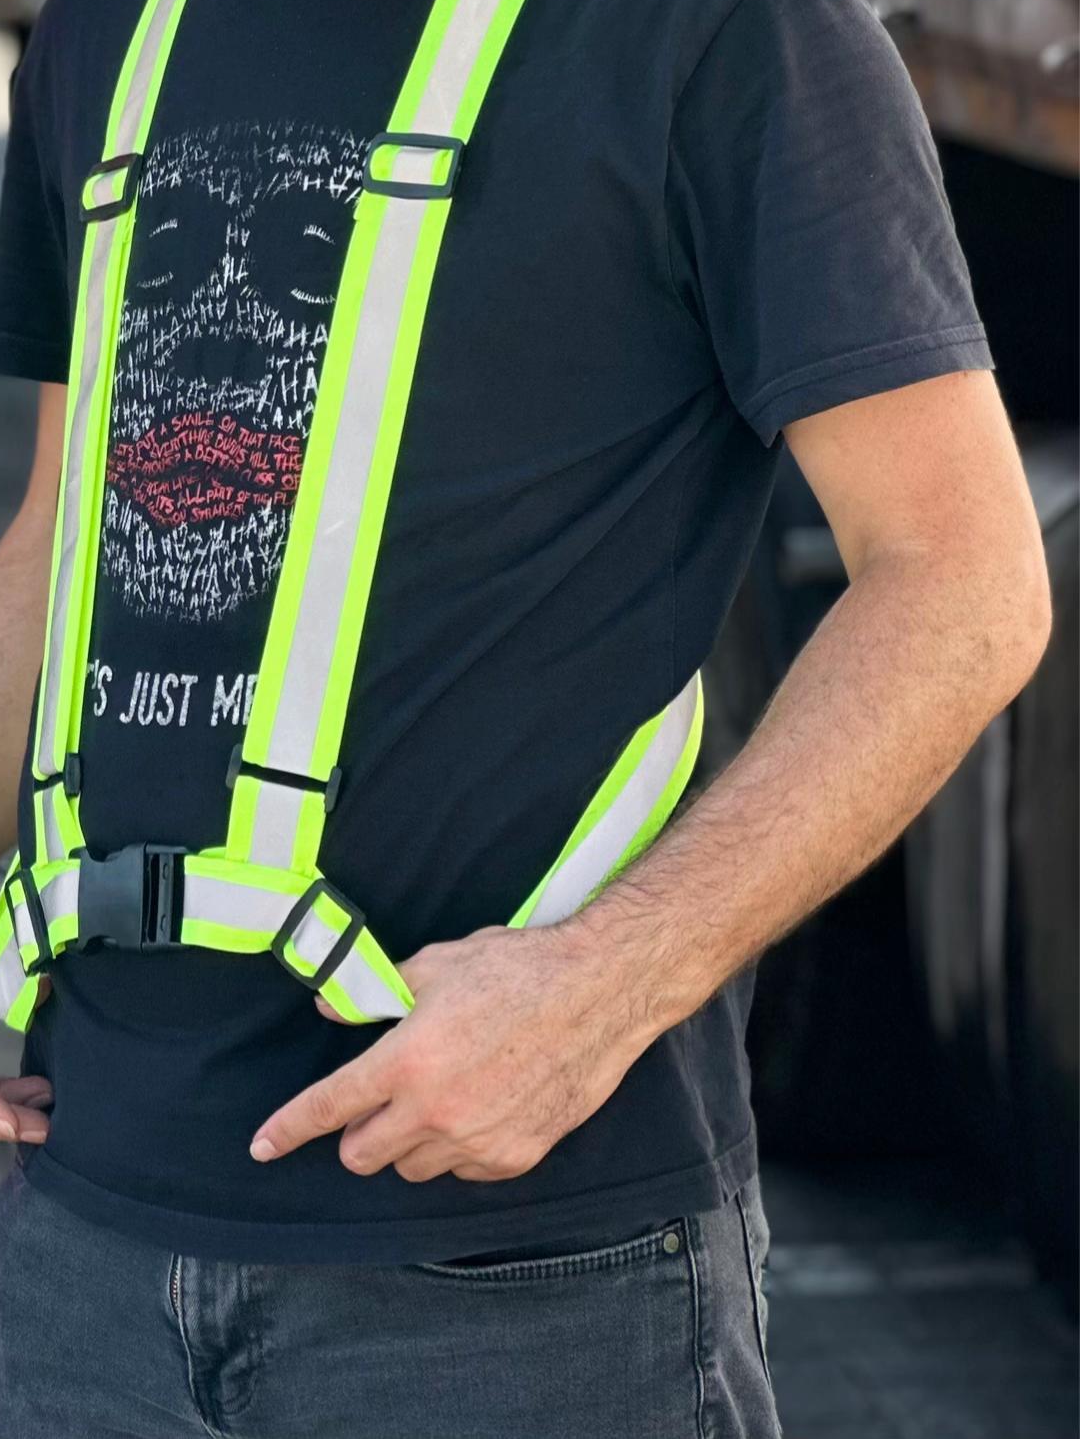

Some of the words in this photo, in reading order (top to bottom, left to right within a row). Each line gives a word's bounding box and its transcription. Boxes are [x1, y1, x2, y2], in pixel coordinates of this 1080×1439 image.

[136, 427, 156, 459] PUT
[171, 410, 215, 432] SMILE
[239, 427, 266, 449] THAT
[267, 434, 302, 453] FACE
[119, 671, 199, 727] JUST
